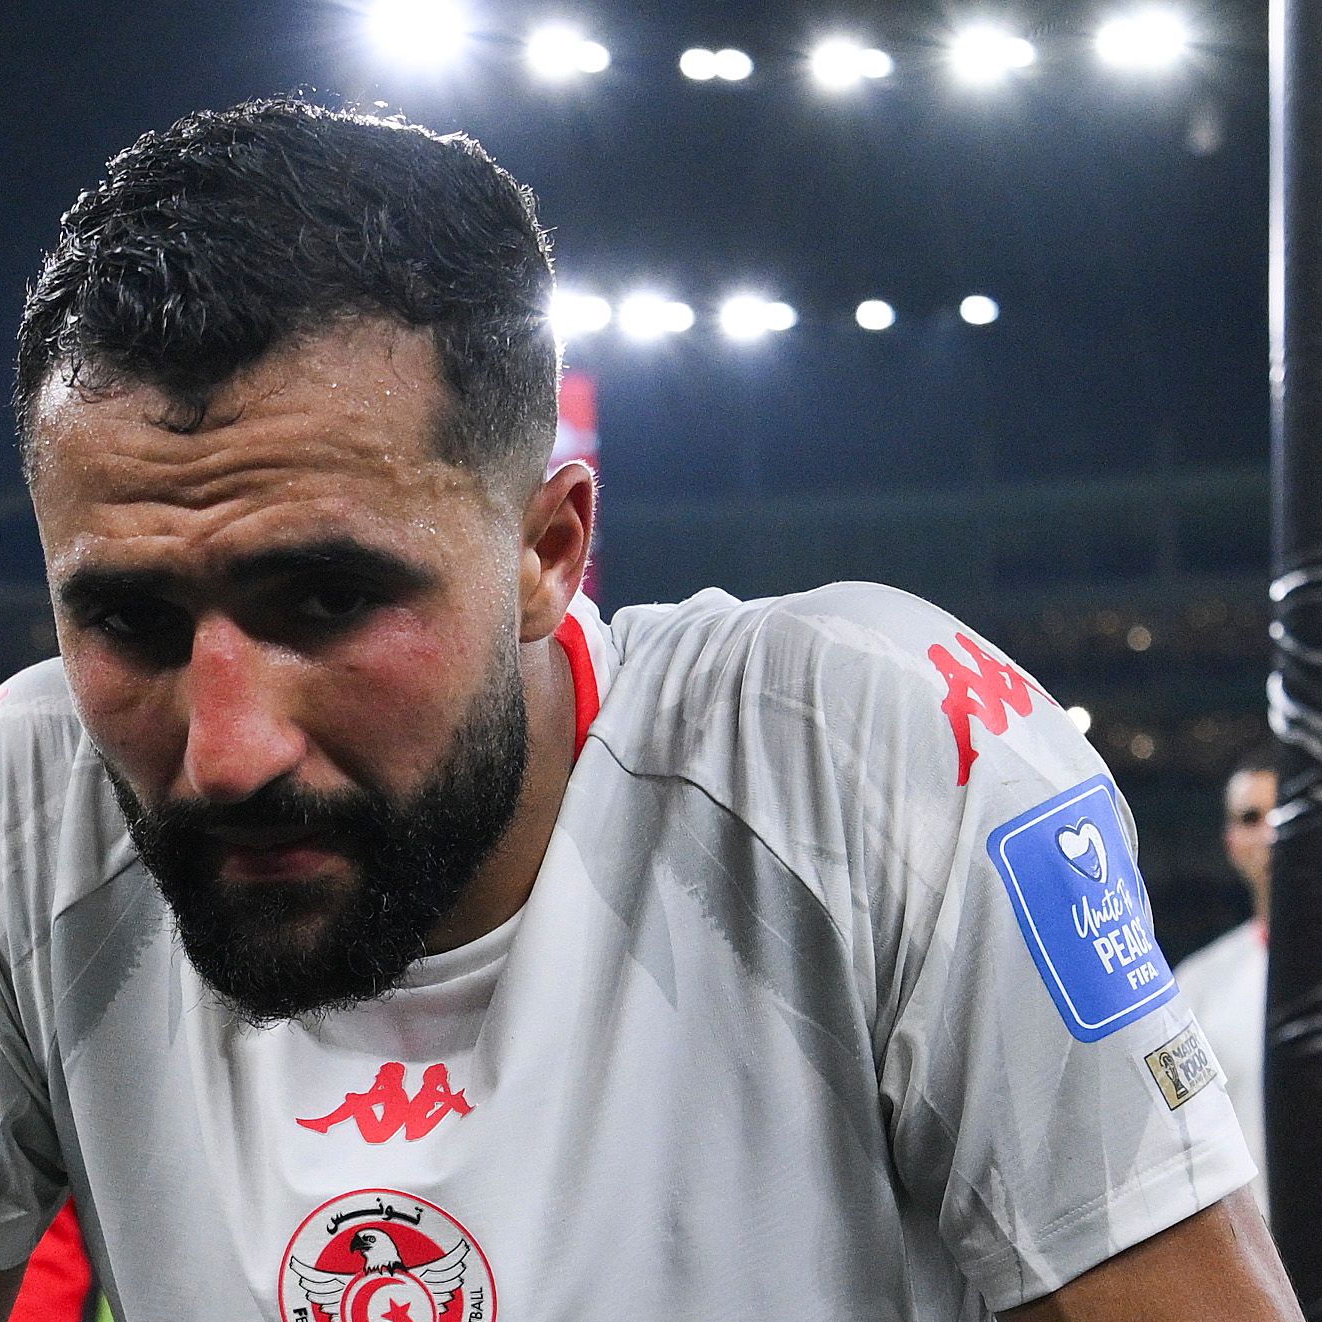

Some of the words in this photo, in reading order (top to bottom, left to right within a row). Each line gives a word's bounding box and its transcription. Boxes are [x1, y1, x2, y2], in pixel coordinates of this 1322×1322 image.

[1072, 889, 1123, 939] Unite
[1093, 916, 1153, 975] PEACE
[1127, 961, 1159, 990] FIFA
